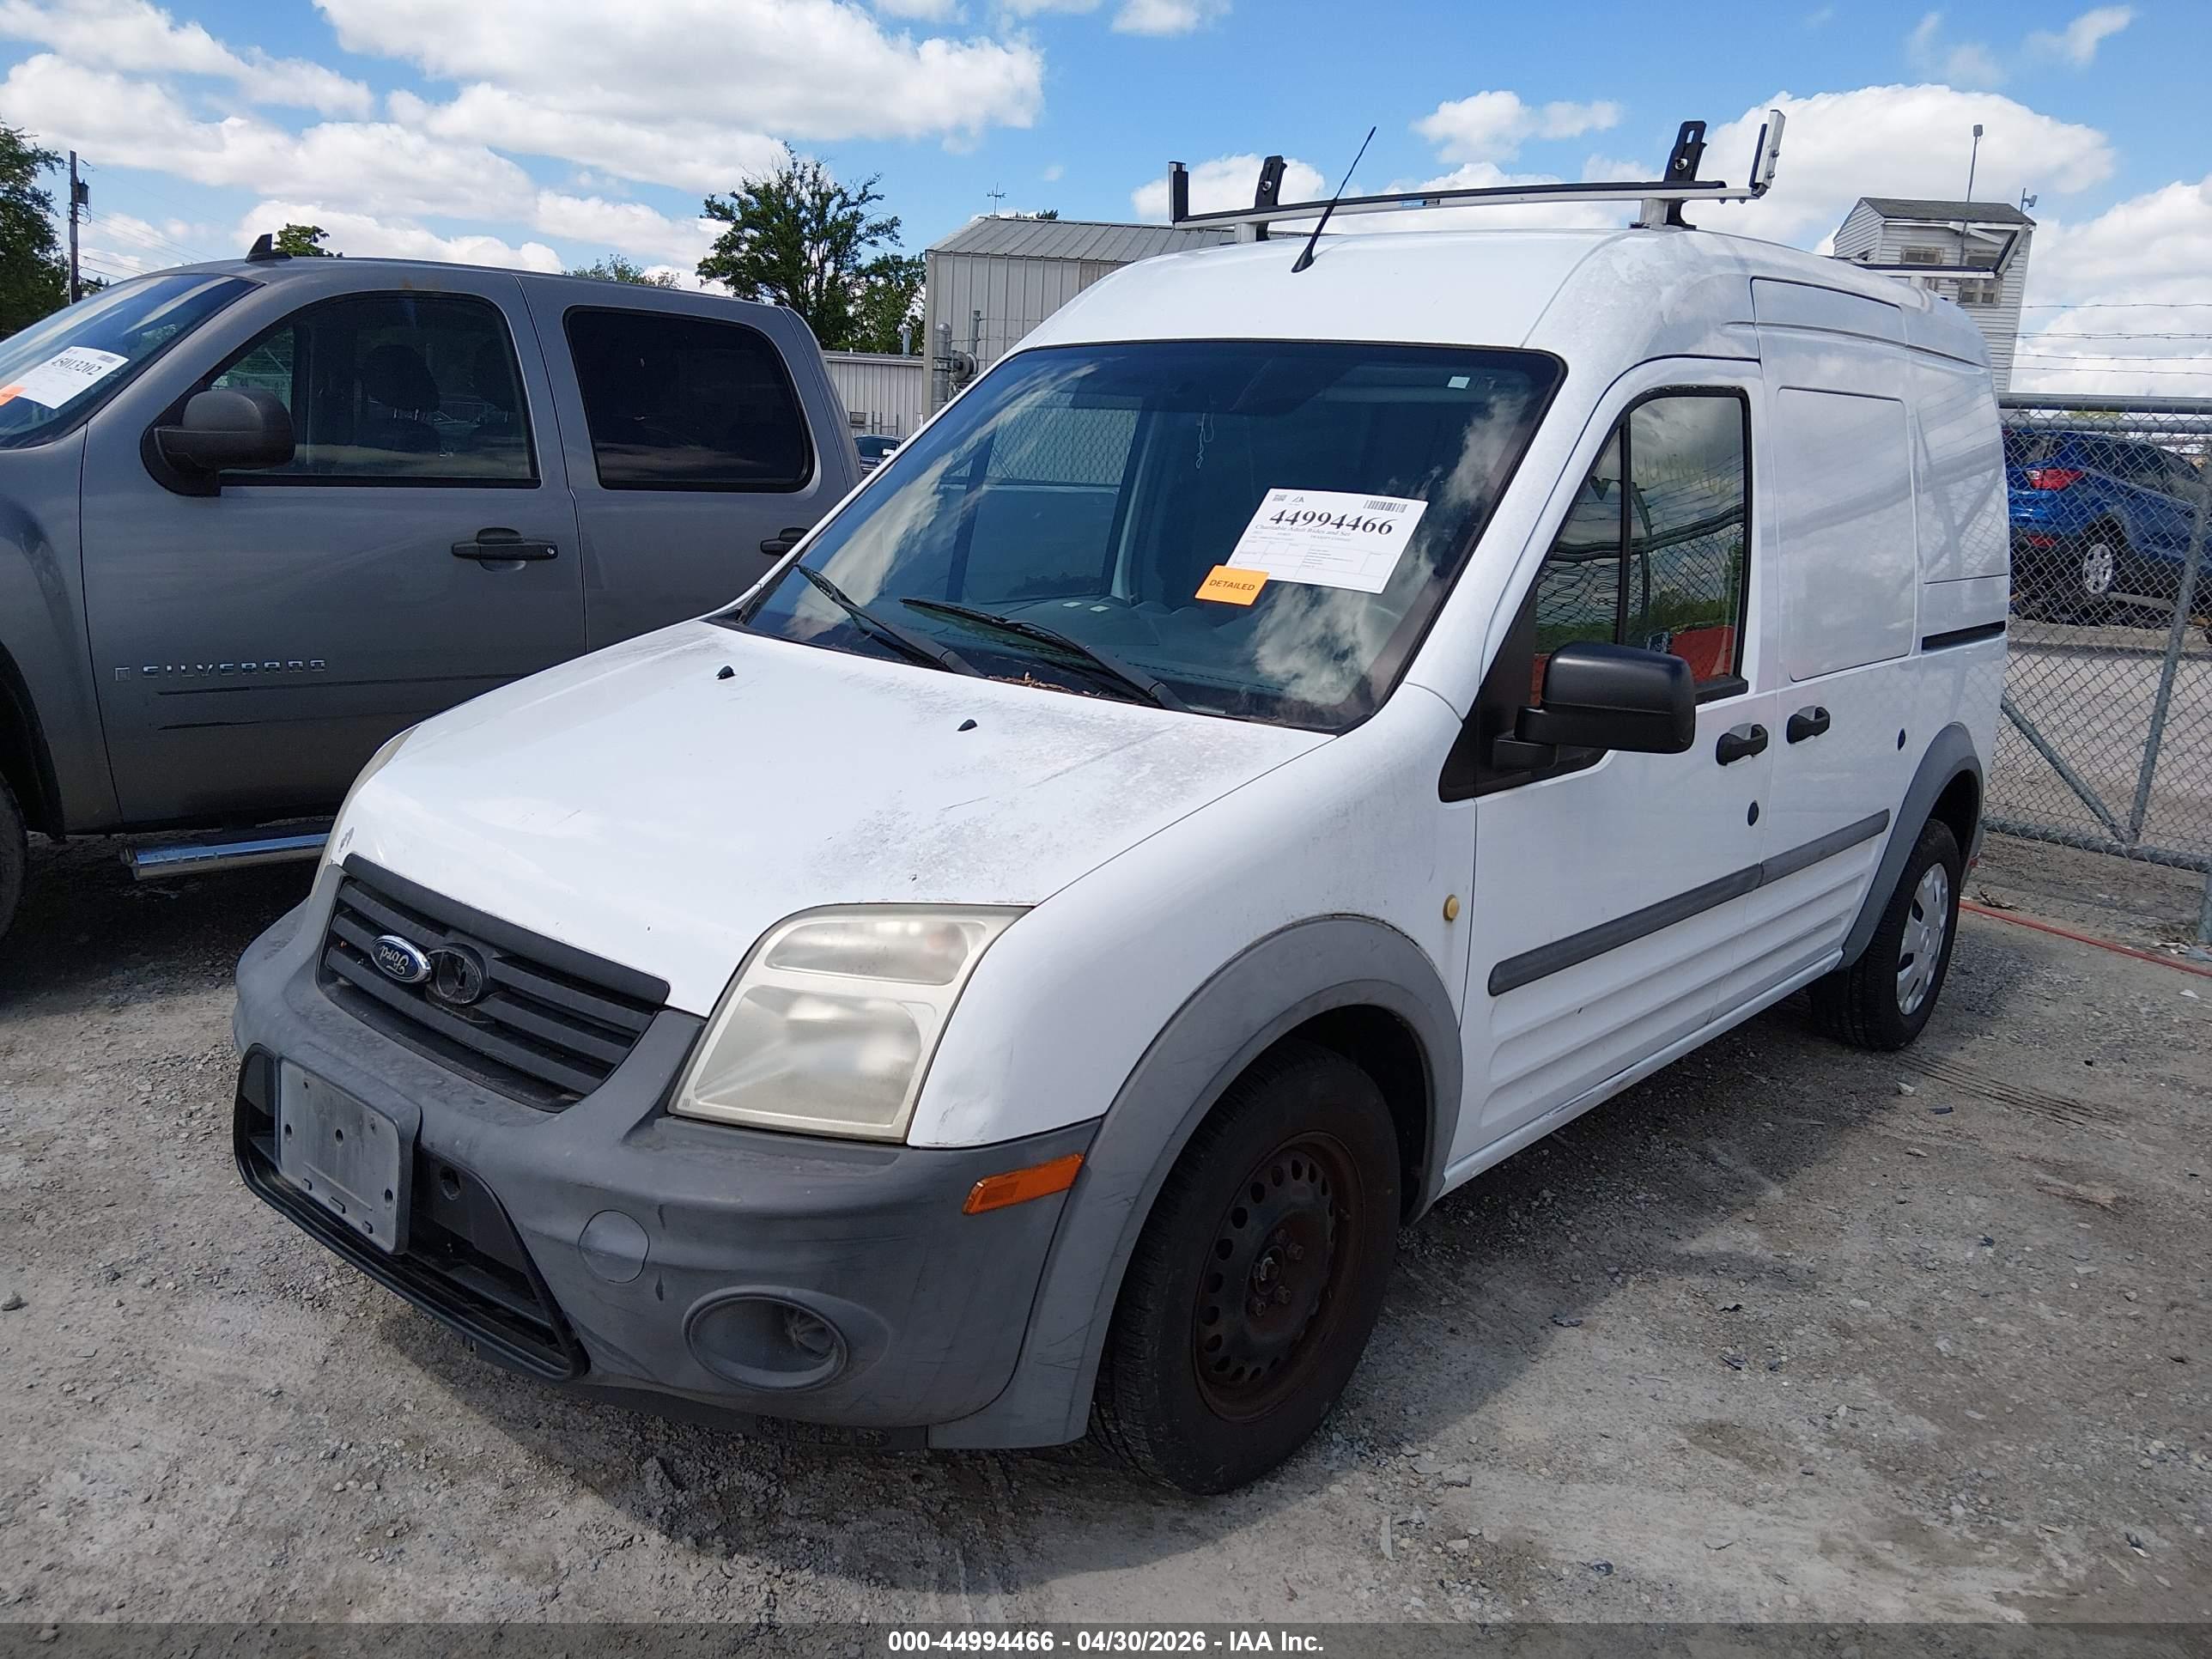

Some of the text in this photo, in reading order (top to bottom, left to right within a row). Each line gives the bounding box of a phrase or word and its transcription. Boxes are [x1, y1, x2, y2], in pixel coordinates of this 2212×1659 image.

[1269, 509, 1398, 536] 44994466
[1209, 579, 1255, 592] DETAILED
[143, 659, 326, 679] SILVERADO
[379, 945, 410, 975] Ford
